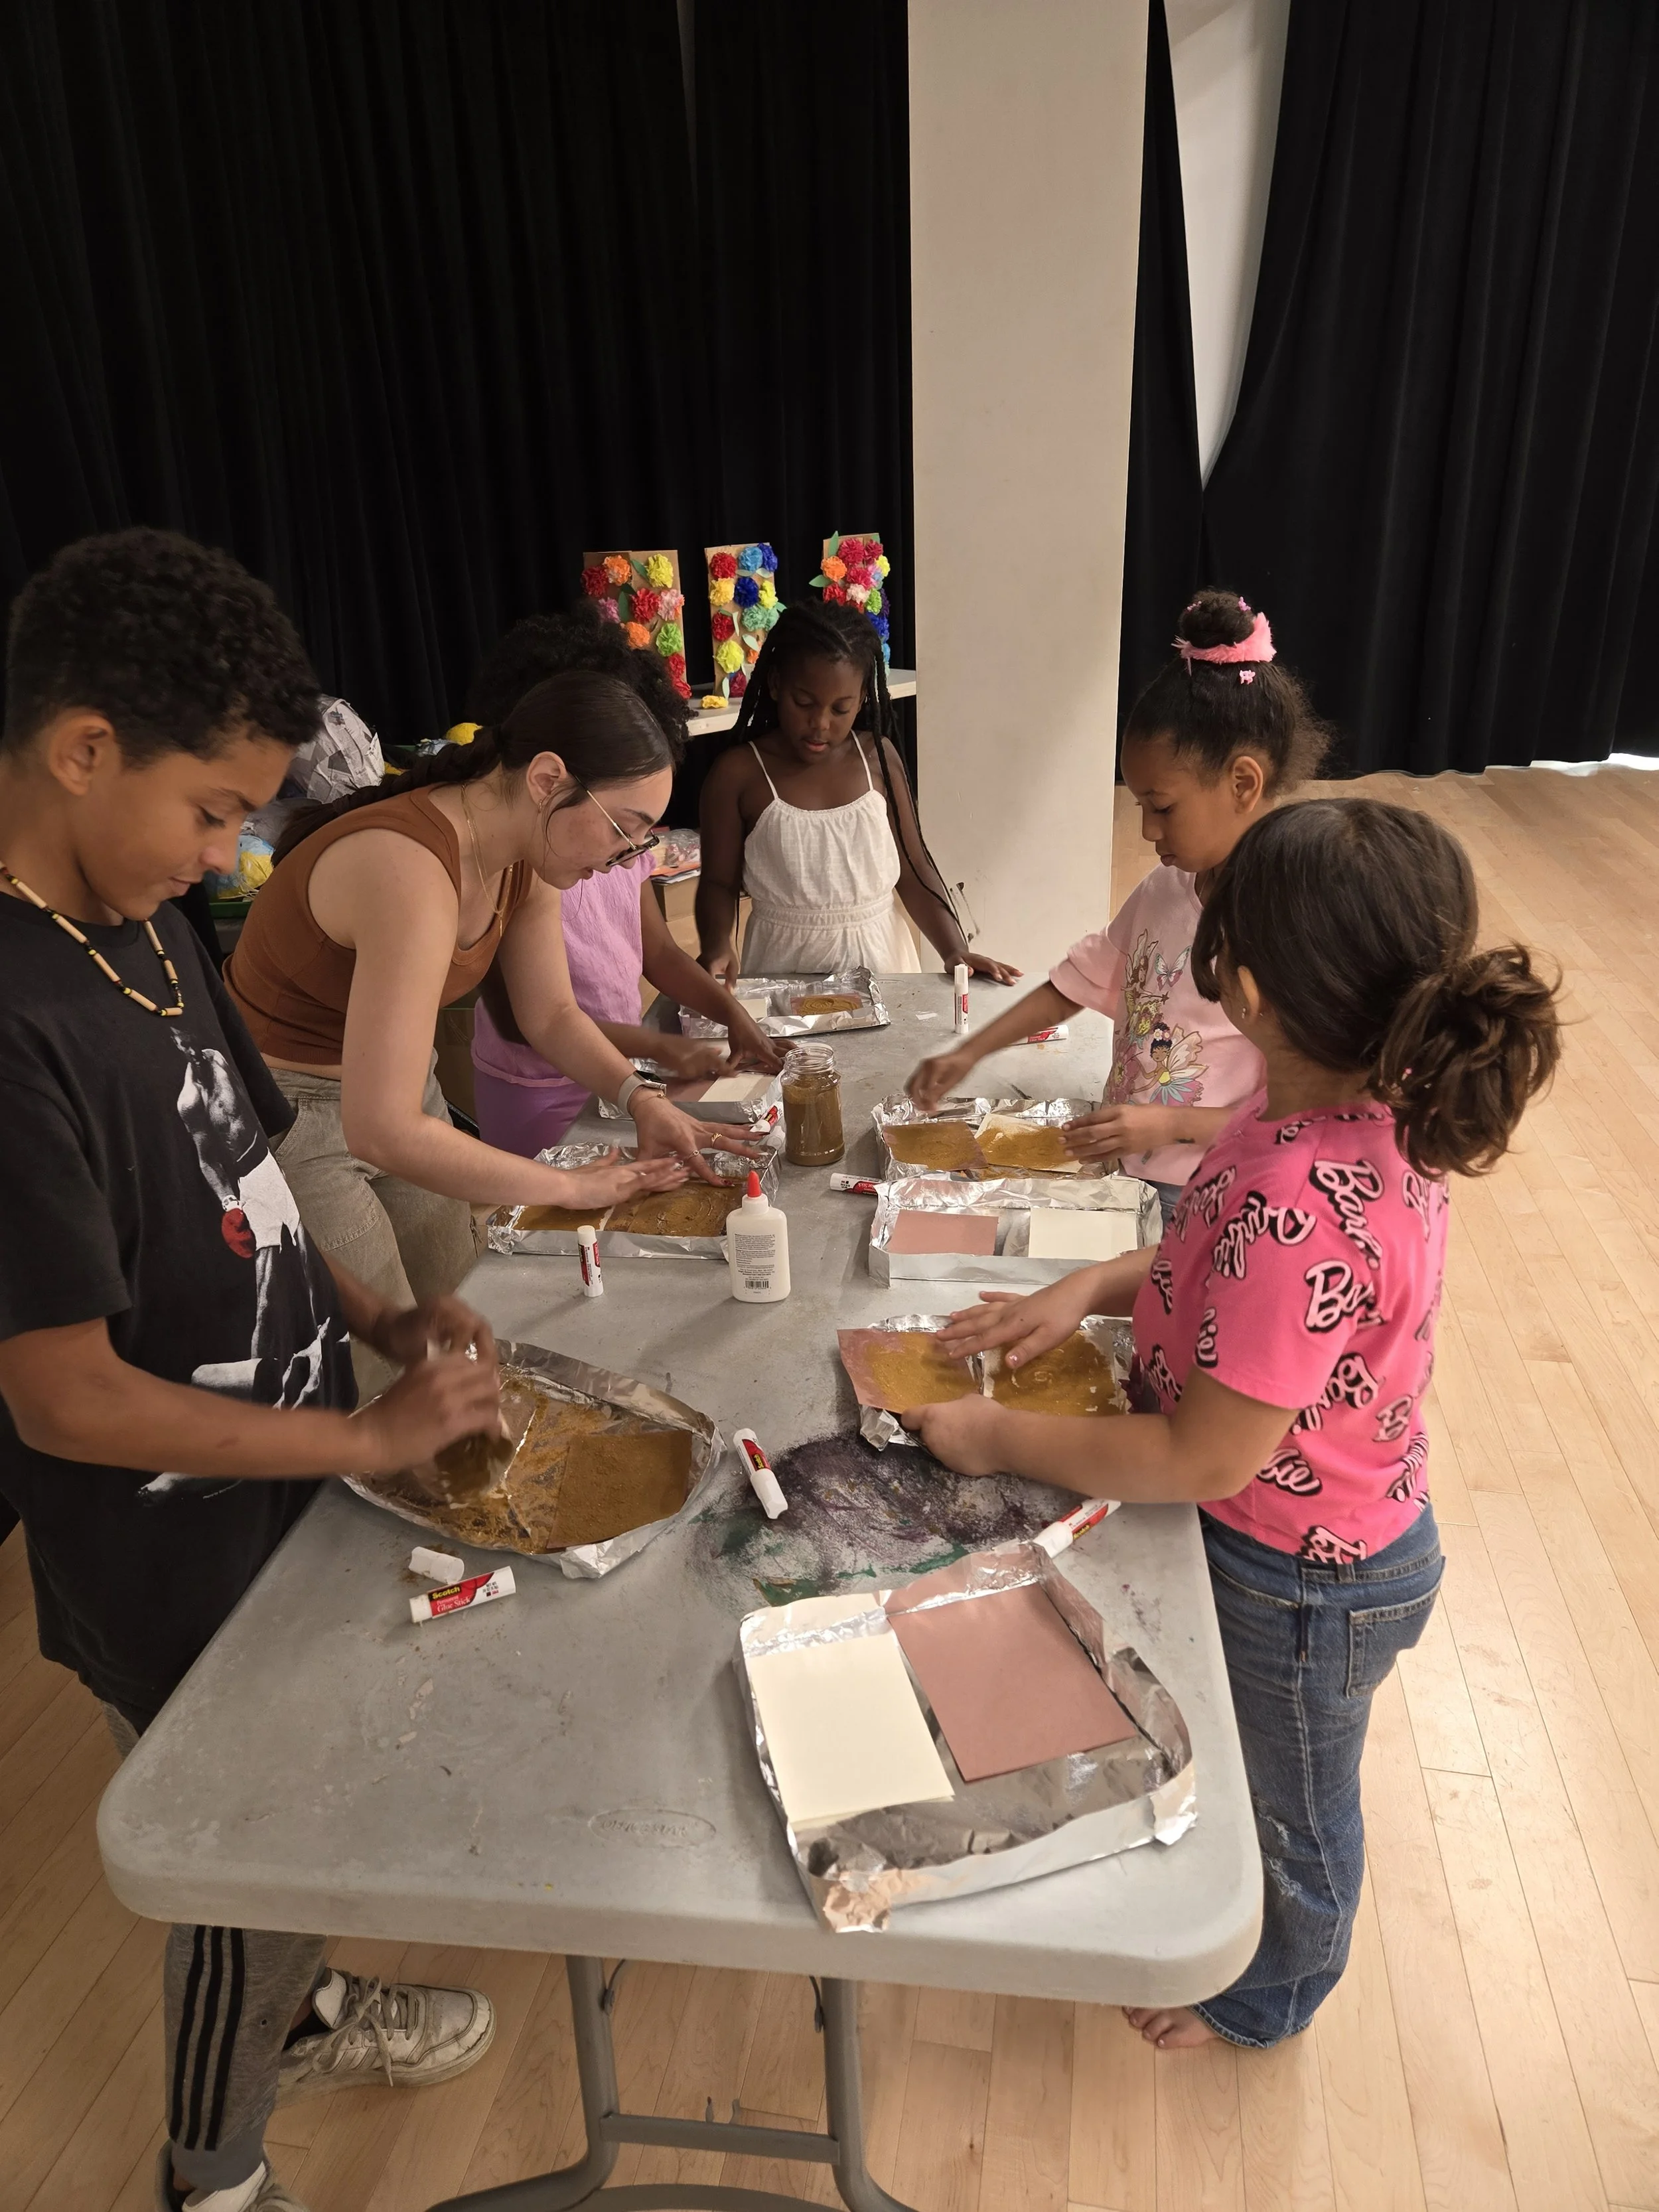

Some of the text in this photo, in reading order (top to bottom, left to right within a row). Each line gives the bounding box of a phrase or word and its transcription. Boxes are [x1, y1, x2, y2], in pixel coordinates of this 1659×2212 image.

[432, 1585, 461, 1600] Scotch
[437, 1596, 471, 1613] Glue Stick
